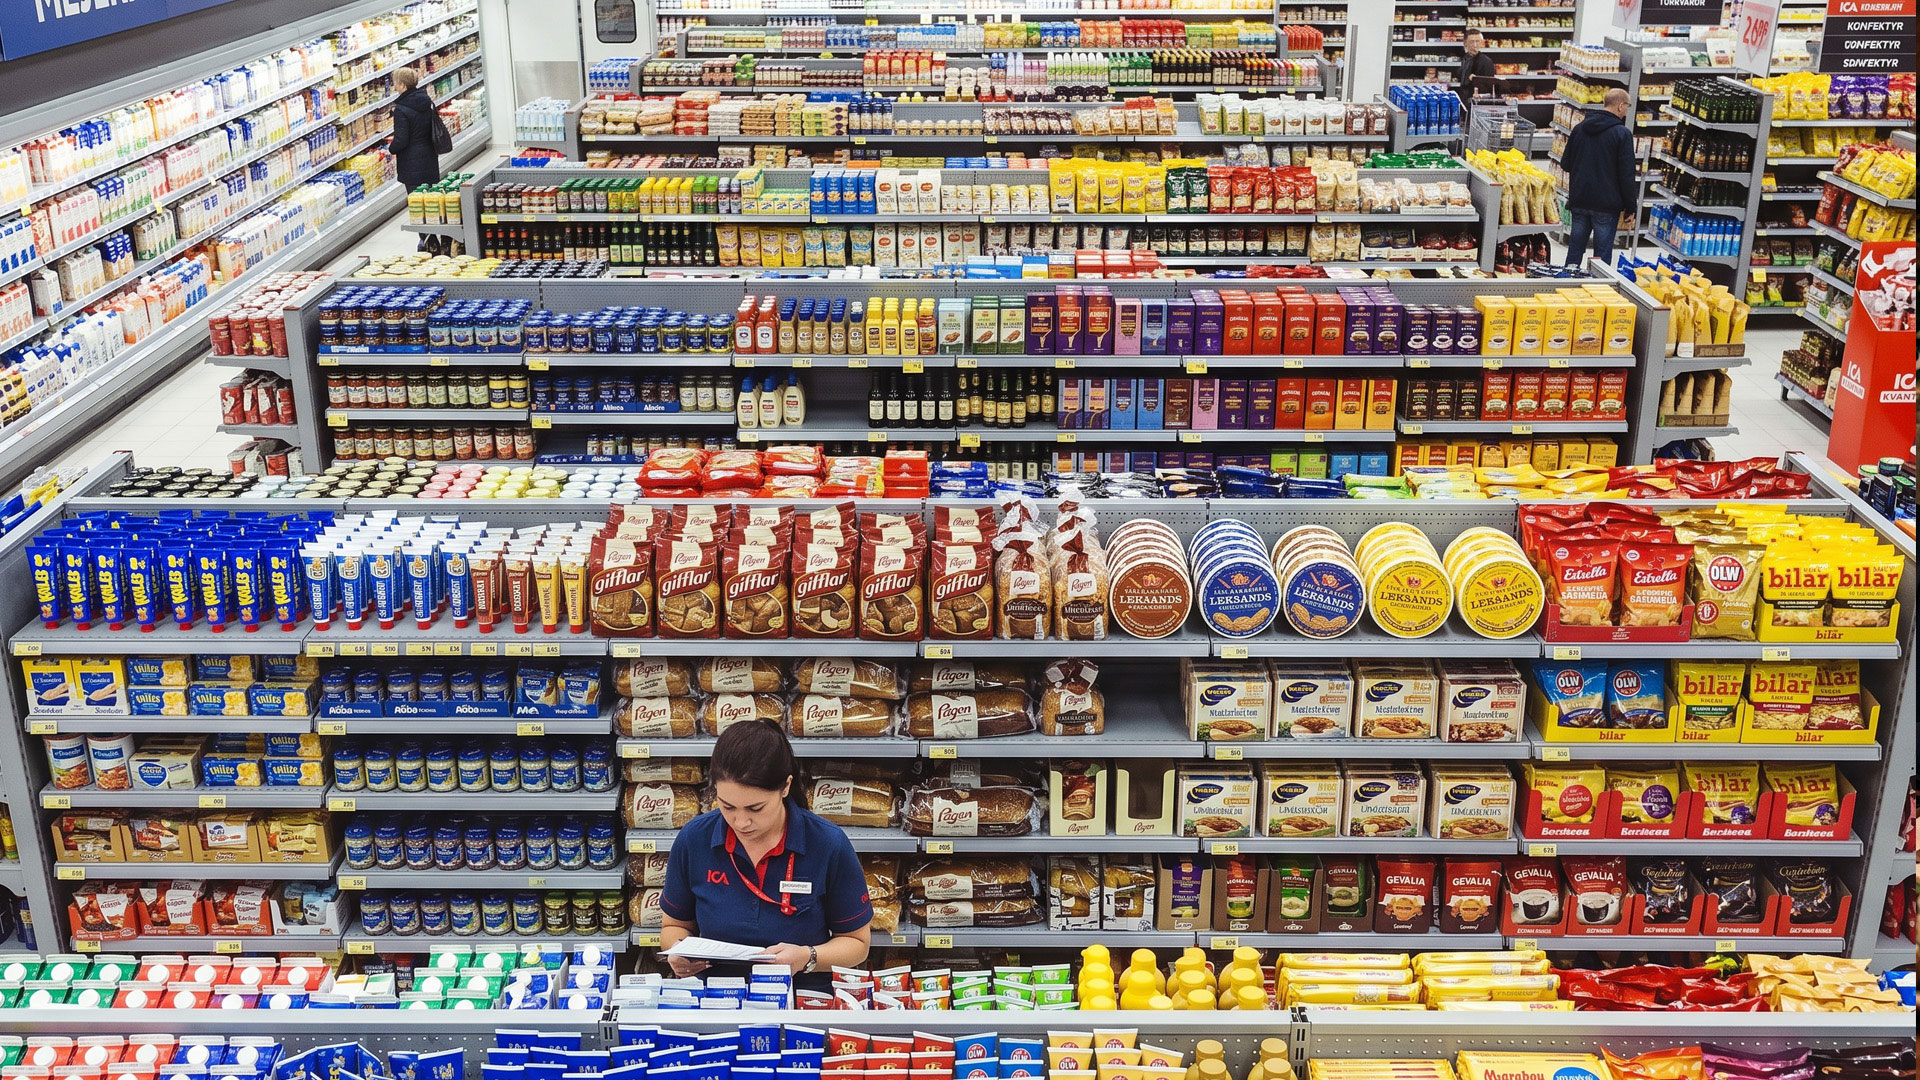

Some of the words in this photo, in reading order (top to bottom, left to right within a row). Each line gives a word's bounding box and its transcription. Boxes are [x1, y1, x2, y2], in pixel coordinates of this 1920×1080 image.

[1840, 1, 1858, 13] ICA
[1847, 22, 1904, 31] KONFEKTYR
[1847, 360, 1861, 384] ICA
[595, 568, 645, 595] gifflar
[1711, 566, 1740, 582] OLW
[1768, 567, 1829, 589] bilar
[1838, 566, 1898, 588] bilar
[662, 569, 712, 597] gifflar
[729, 571, 779, 598] gifflar
[798, 571, 848, 598] gifflar
[865, 572, 915, 599] gifflar
[936, 572, 987, 599] gifflar
[1815, 629, 1844, 641] bilar
[1557, 676, 1580, 688] OLW
[1615, 676, 1638, 688] OLW
[1683, 674, 1743, 697] bilar
[1754, 672, 1813, 695] bilar
[1599, 730, 1627, 740] bilar
[1681, 730, 1710, 740] bilar
[1795, 731, 1824, 742] bilar
[1694, 773, 1752, 793] bilar
[1774, 774, 1832, 794] bilar
[707, 869, 730, 886] ICA
[1386, 876, 1426, 887] GEVALIA
[1452, 877, 1492, 887] GEVALIA
[1514, 868, 1553, 880] GEVALIA
[1574, 871, 1614, 883] GEVALIA
[1059, 1061, 1077, 1070] OLW
